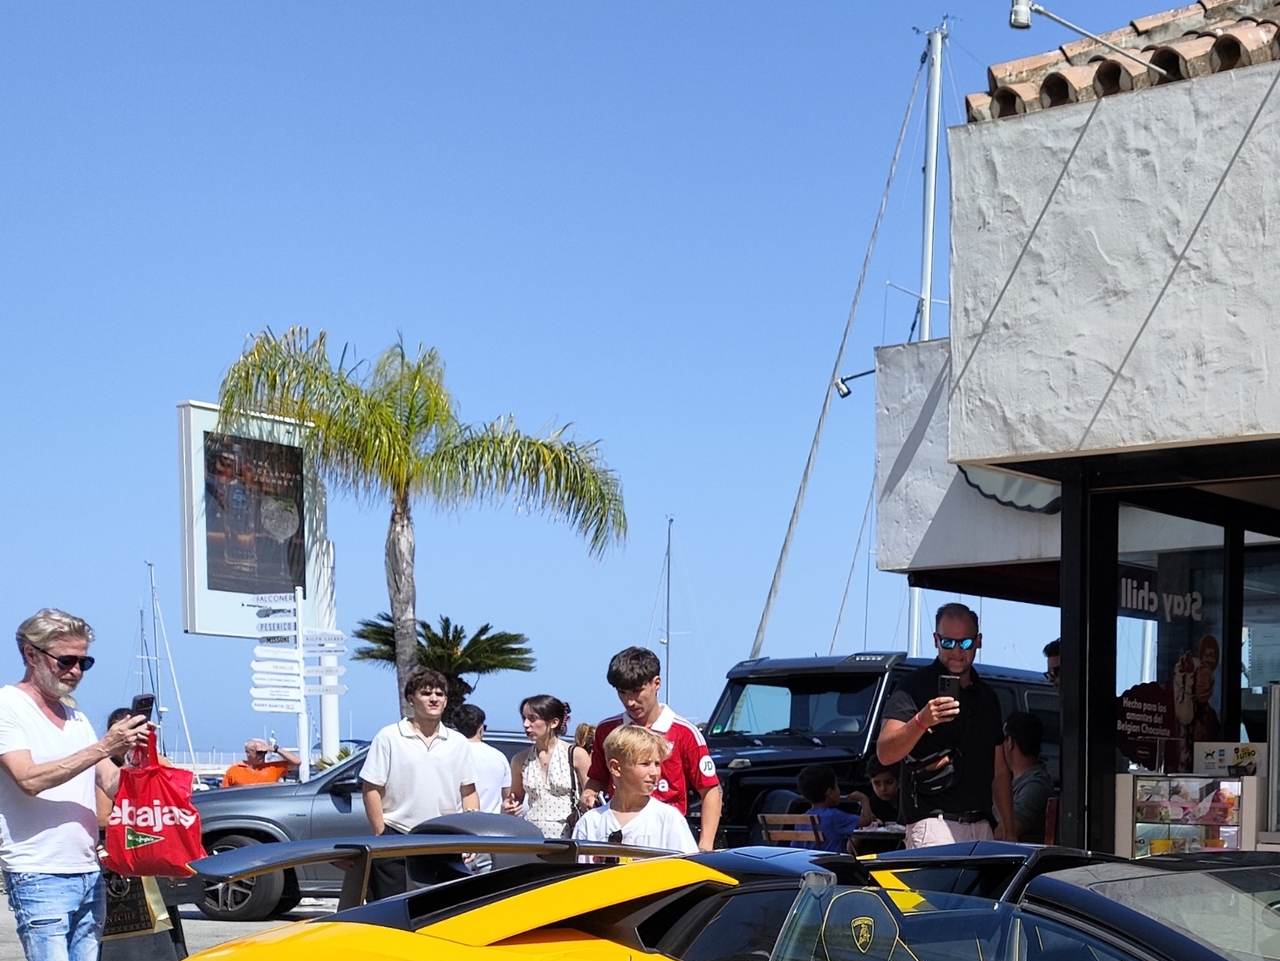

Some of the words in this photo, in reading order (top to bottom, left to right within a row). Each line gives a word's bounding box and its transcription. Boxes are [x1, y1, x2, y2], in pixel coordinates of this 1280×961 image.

[1123, 696, 1142, 710] Hecho
[1143, 702, 1157, 713] para
[1157, 702, 1167, 713] los
[1126, 712, 1152, 723] amantes
[1153, 714, 1163, 724] del
[1117, 719, 1140, 735] Belgian
[1141, 723, 1171, 737] Chocolate
[703, 760, 713, 771] JD
